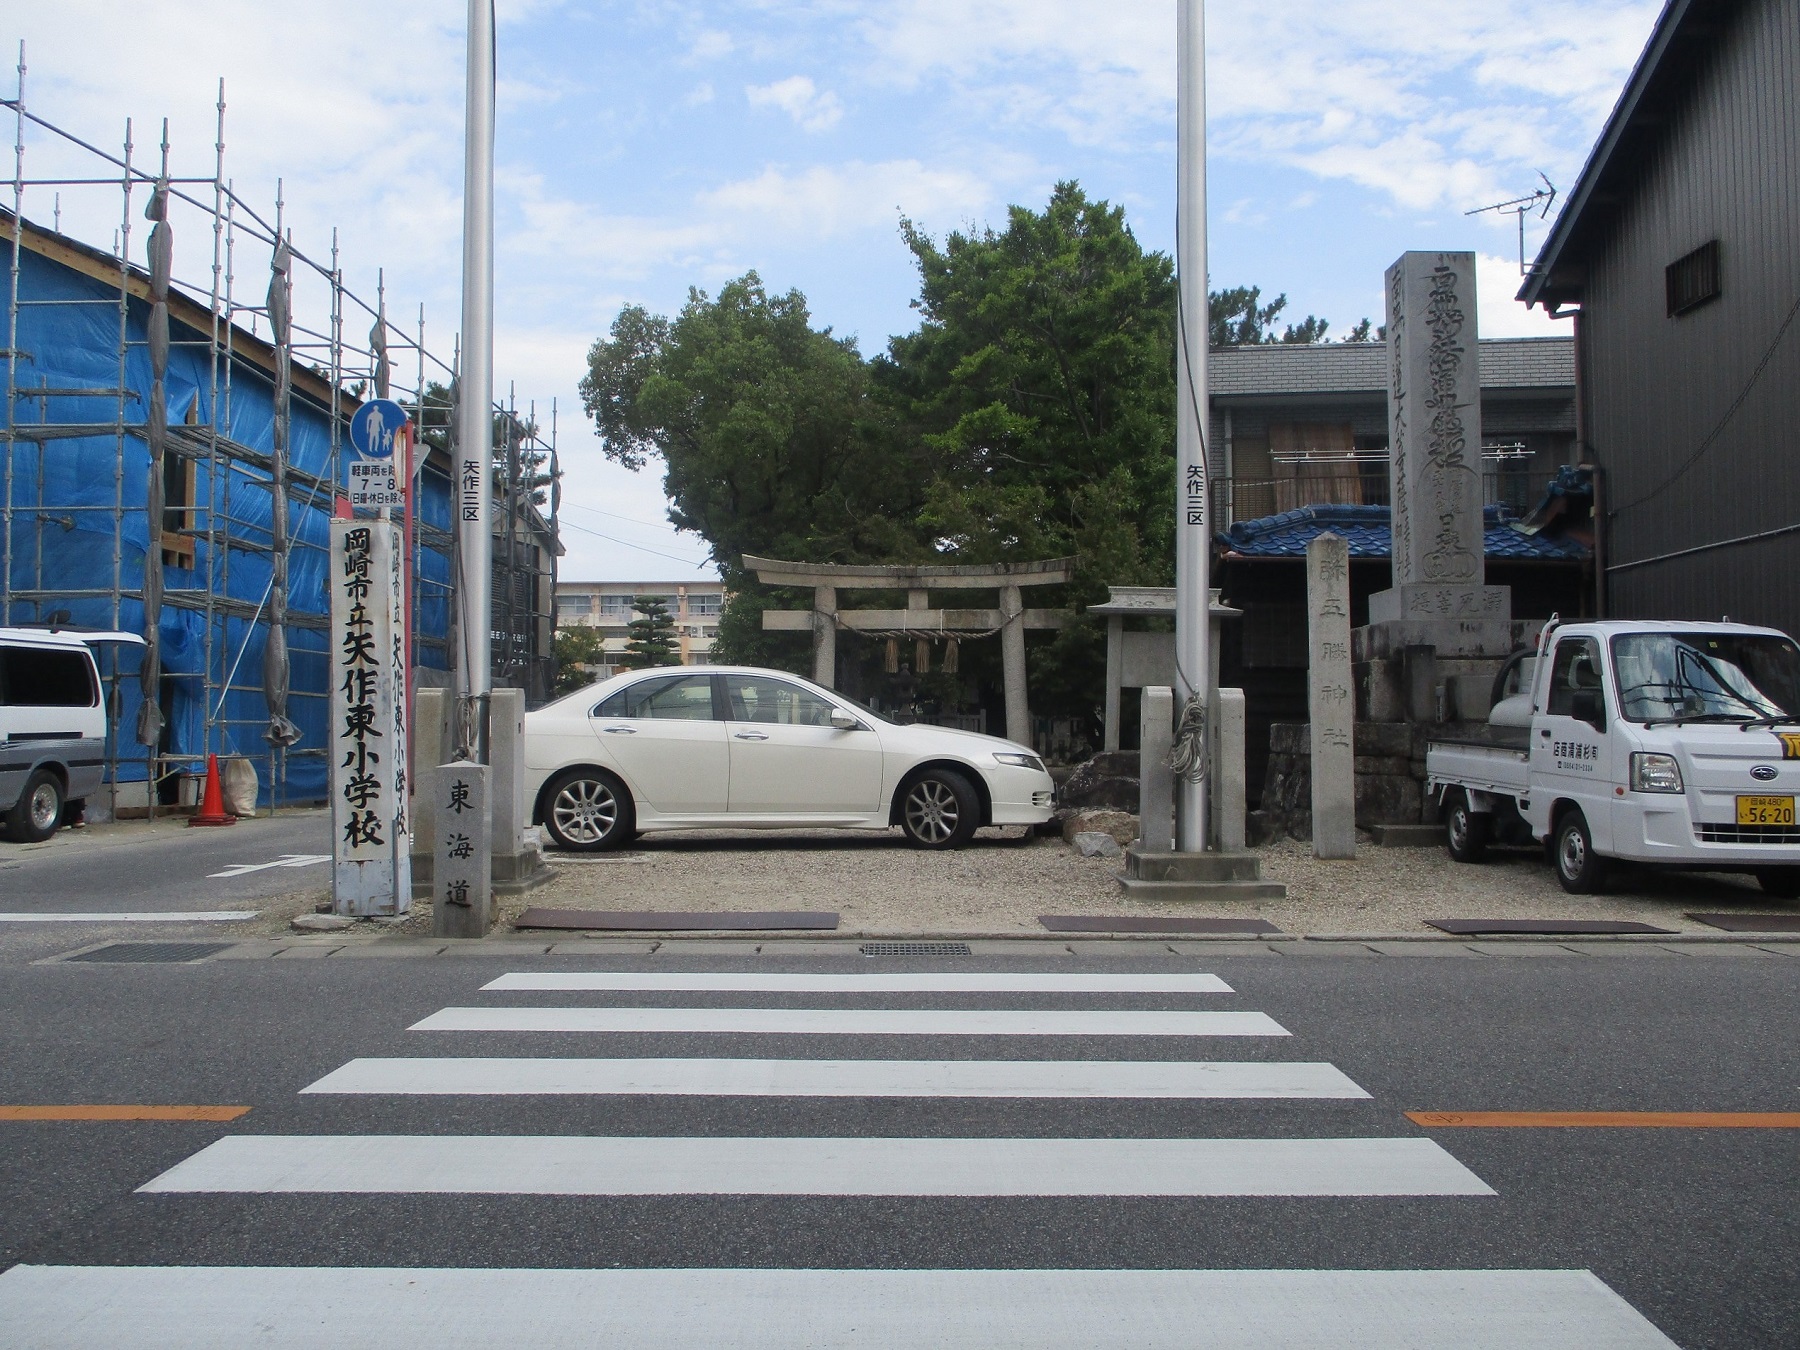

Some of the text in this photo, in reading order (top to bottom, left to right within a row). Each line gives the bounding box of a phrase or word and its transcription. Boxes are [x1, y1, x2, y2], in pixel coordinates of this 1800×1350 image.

[462, 459, 480, 521] 矢作三区
[1186, 464, 1203, 525] 矢作三区
[341, 527, 384, 849] 岡崎市立矢作東小学校
[1749, 807, 1792, 823] 56-20
[1767, 798, 1782, 806] 480
[446, 779, 475, 908] 東海道
